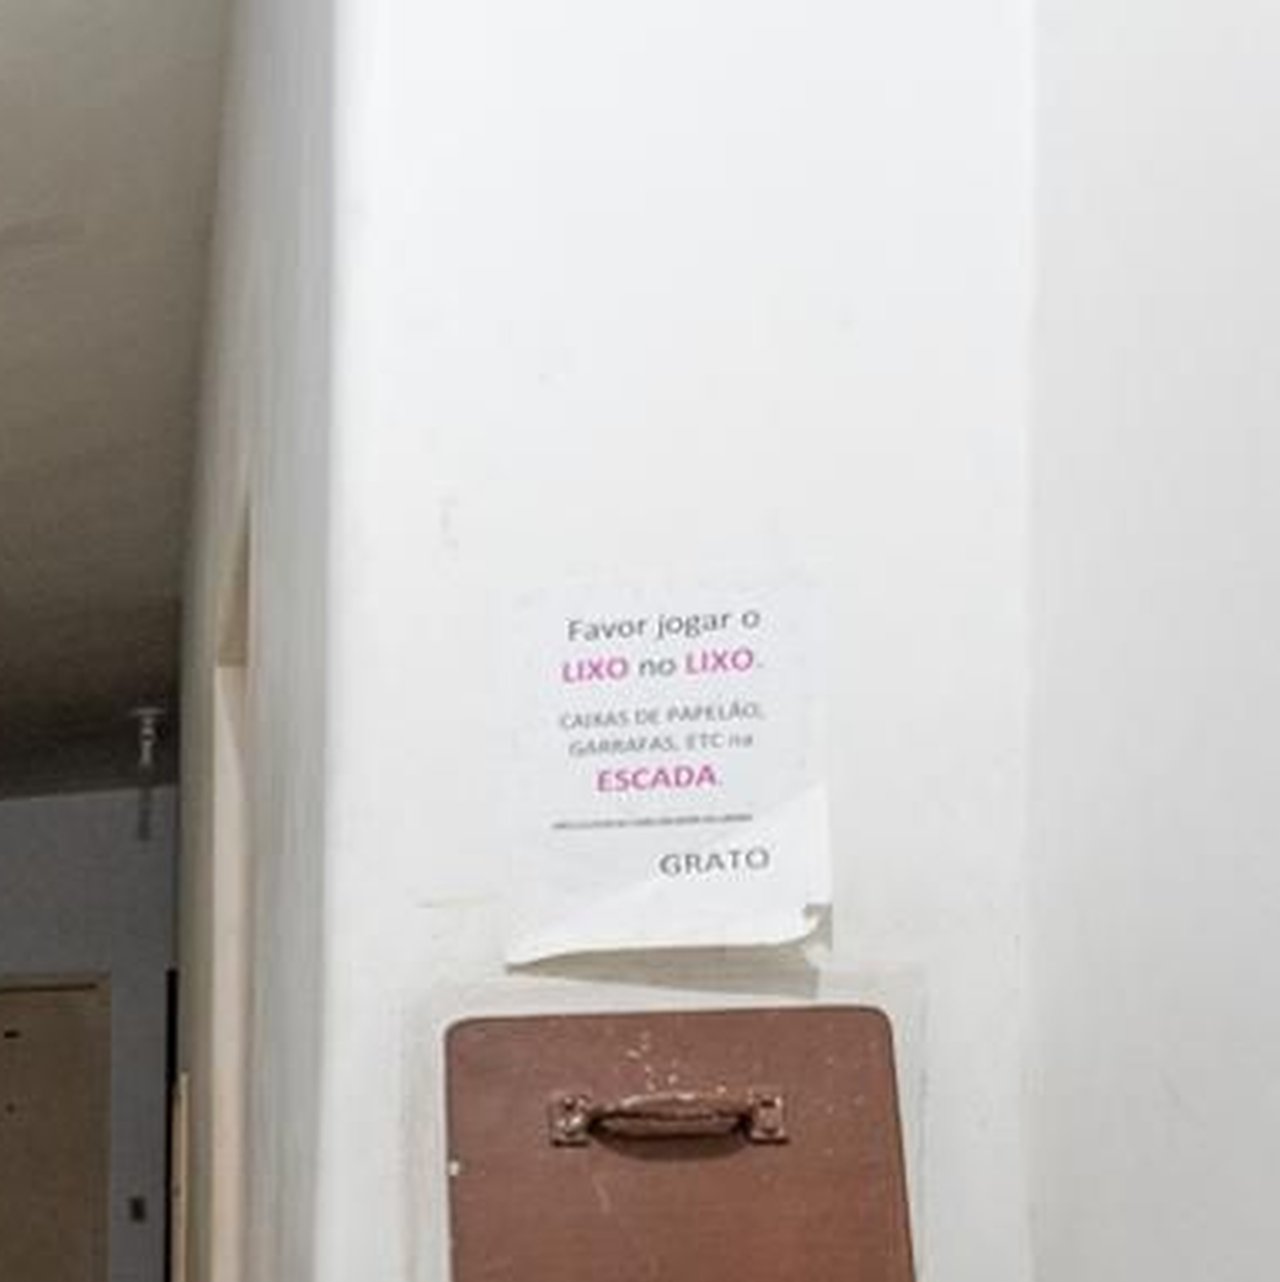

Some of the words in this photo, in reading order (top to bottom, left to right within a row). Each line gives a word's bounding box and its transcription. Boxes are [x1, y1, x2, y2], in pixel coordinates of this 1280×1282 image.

[566, 617, 647, 642] Favor
[656, 612, 731, 640] jogar
[740, 610, 761, 629] o
[561, 656, 629, 683] LIXO
[639, 658, 677, 677] no
[685, 646, 765, 675] LIXO.
[560, 709, 629, 731] CAIXAS
[634, 709, 660, 725] DE
[685, 731, 725, 750] ETC
[658, 847, 770, 876] GRATO
